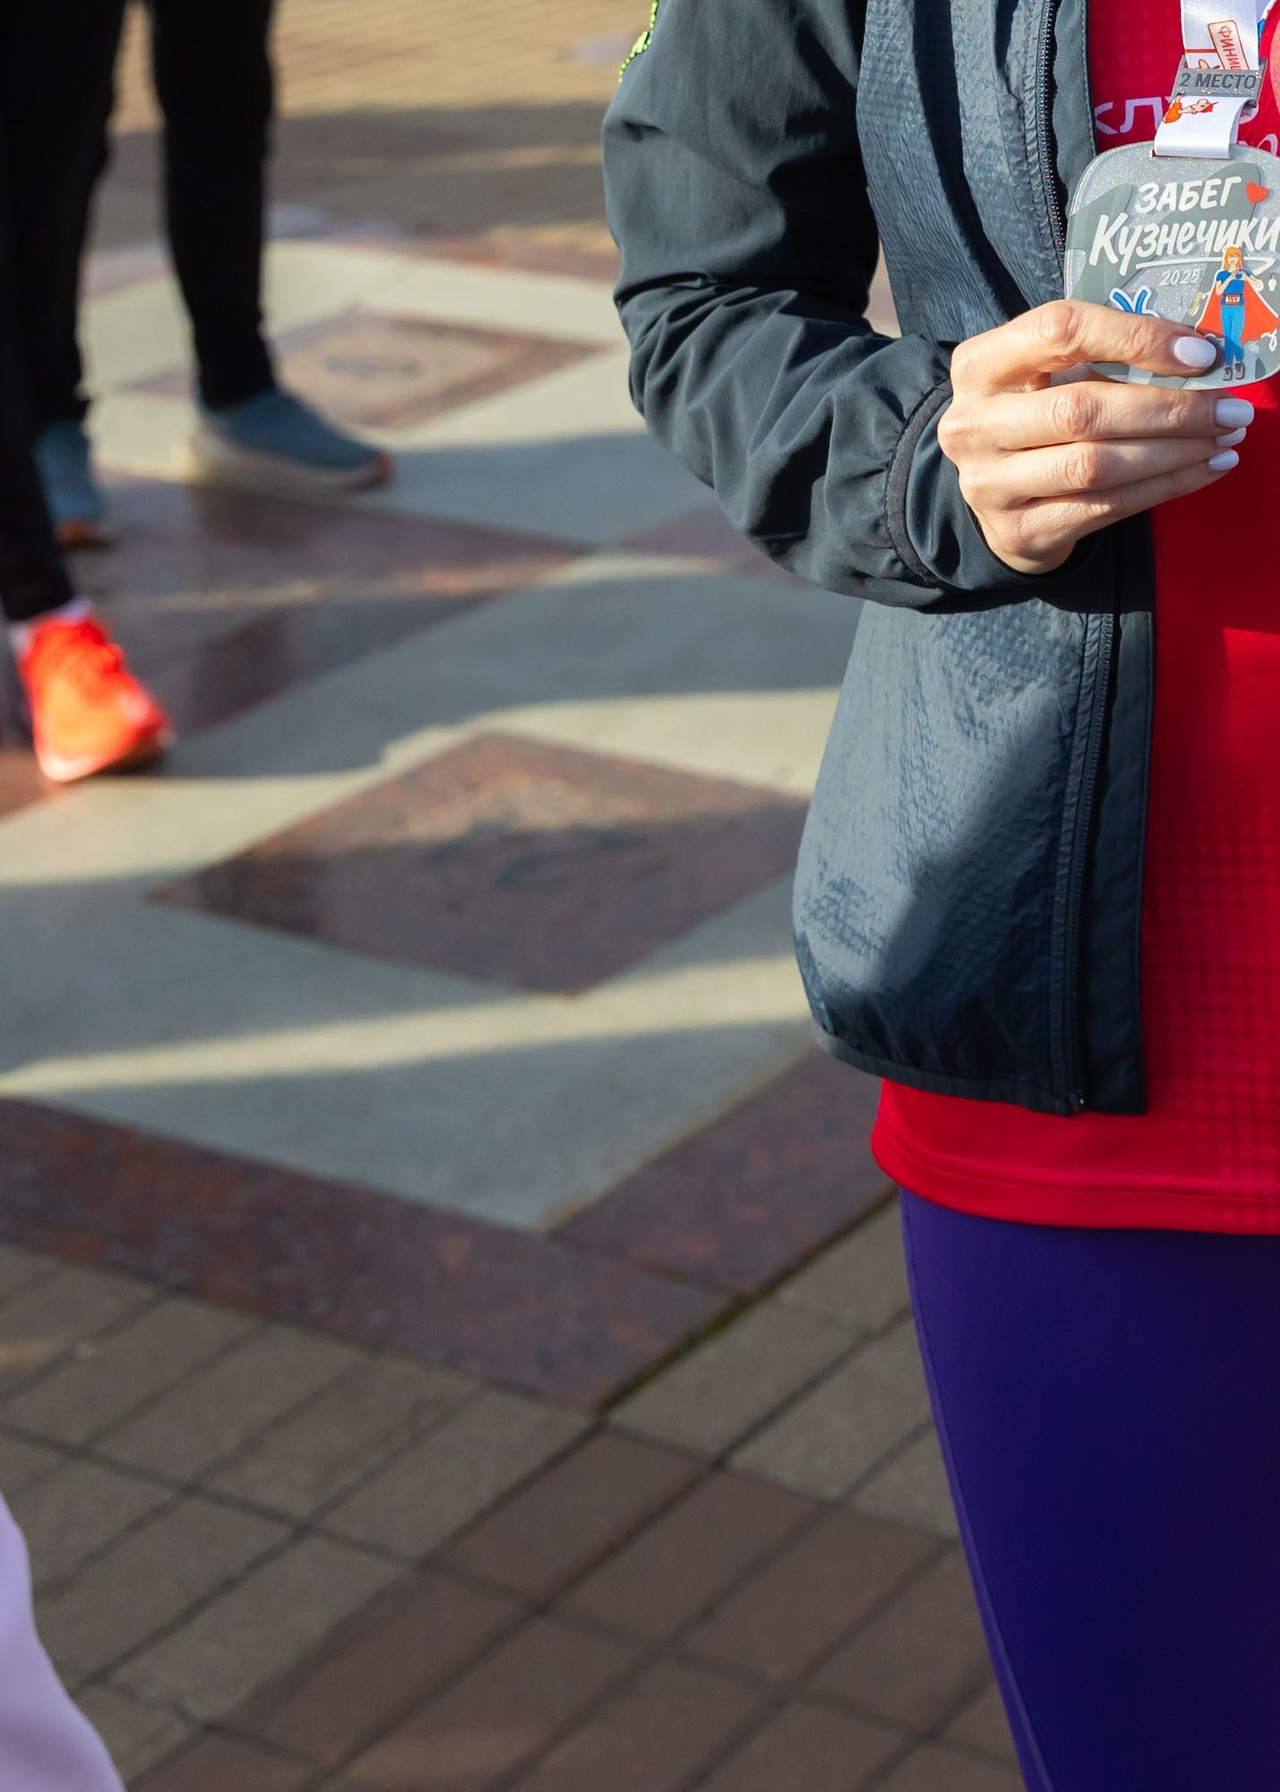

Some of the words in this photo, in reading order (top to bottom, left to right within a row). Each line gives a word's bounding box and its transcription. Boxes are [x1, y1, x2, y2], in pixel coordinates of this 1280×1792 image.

[1218, 25, 1242, 70] ФИНИ
[1179, 72, 1191, 87] 2
[1194, 73, 1257, 90] МЕСТО
[1137, 176, 1242, 213] ЗАБЕГ
[1158, 269, 1201, 287] 2025
